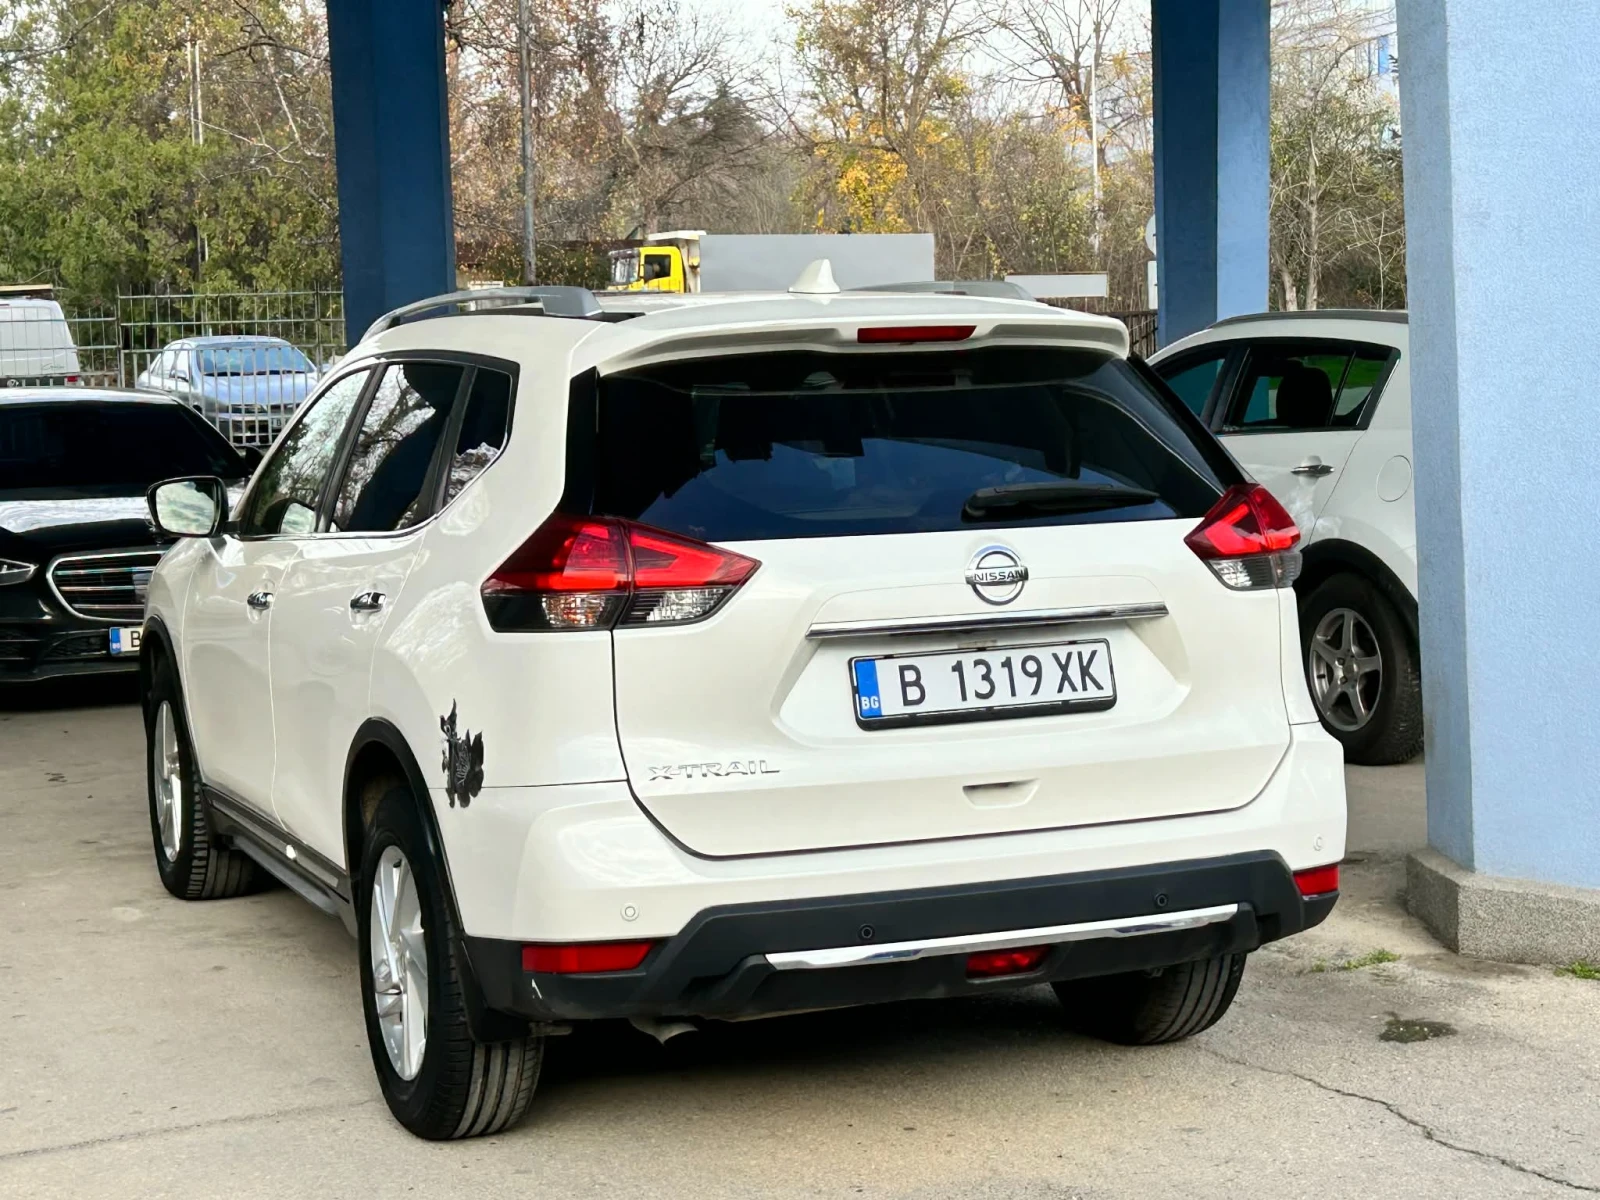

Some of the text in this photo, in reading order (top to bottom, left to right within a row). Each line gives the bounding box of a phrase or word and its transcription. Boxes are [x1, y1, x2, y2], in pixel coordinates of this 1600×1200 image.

[973, 569, 1025, 582] NISSAN
[898, 649, 1105, 707] B 1319 XK
[861, 696, 879, 710] BG
[648, 760, 780, 781] X-TRAIL
